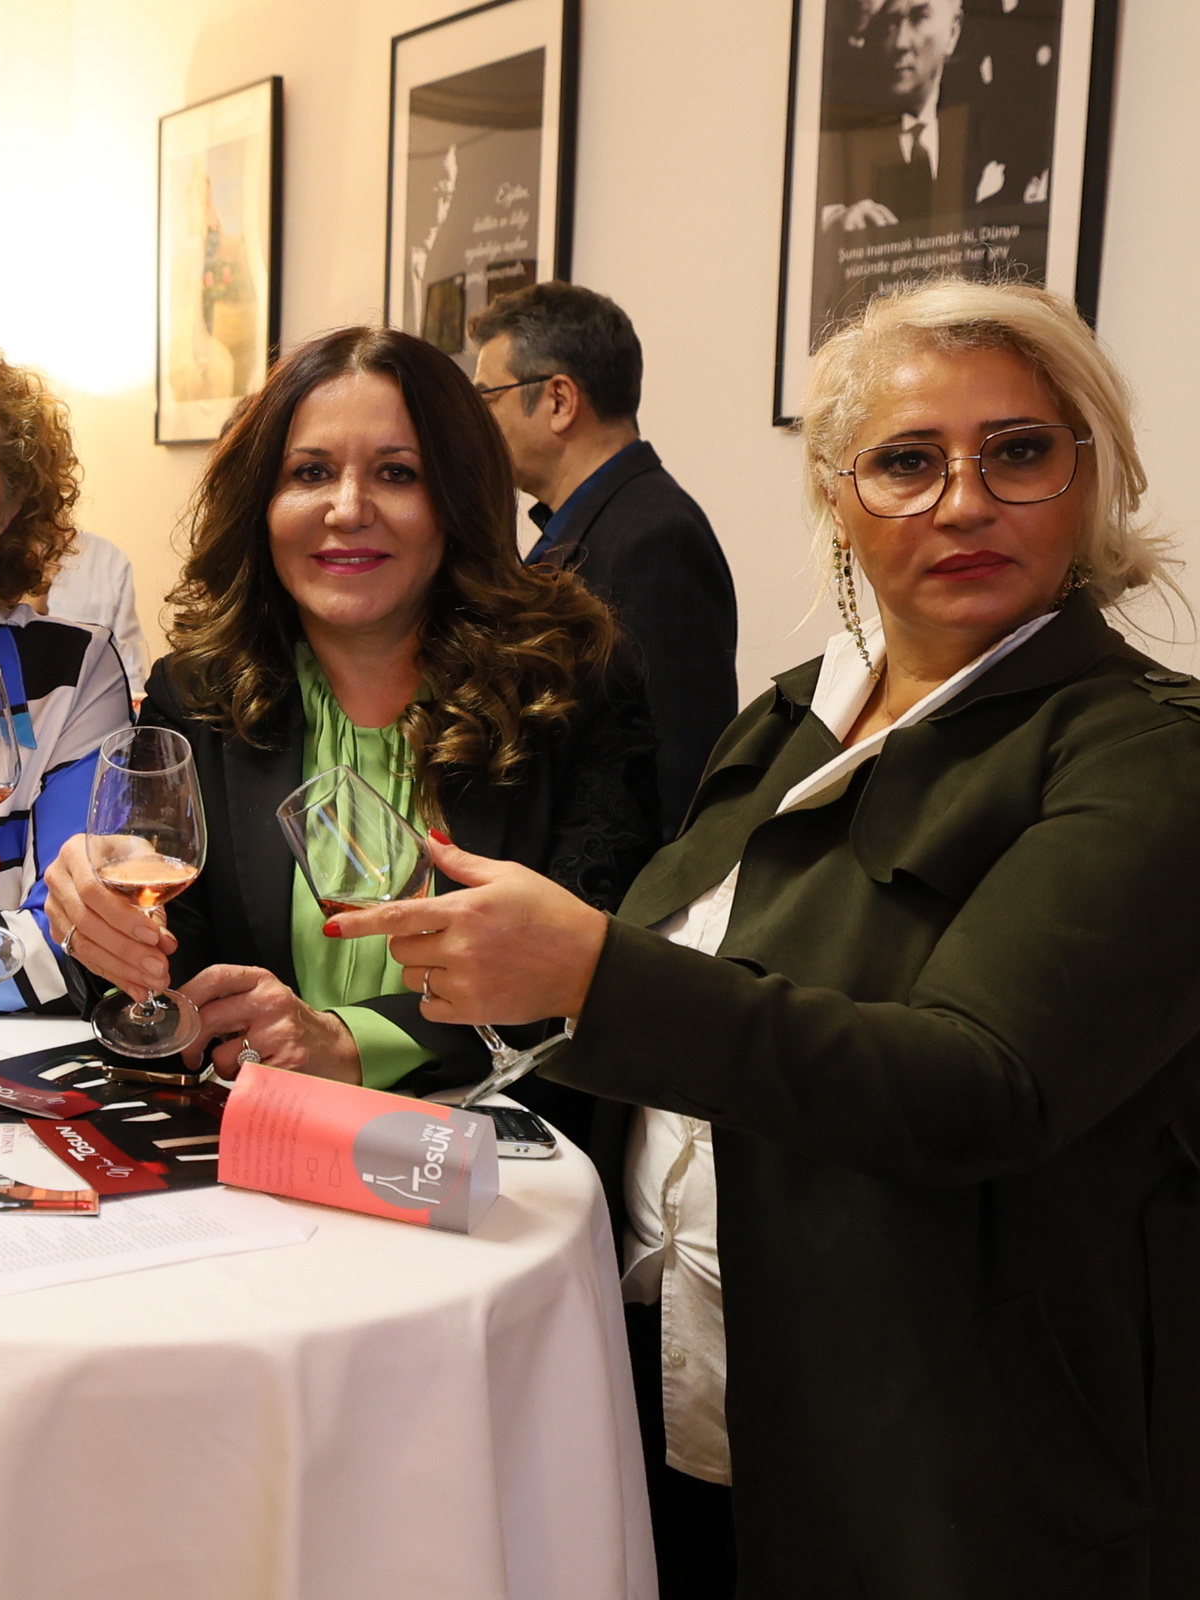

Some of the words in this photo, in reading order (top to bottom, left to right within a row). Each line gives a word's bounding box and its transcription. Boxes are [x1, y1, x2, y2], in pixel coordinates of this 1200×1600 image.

[980, 225, 1020, 241] Dünya
[420, 1123, 436, 1142] VIN
[464, 1121, 478, 1138] Rosé
[55, 1126, 96, 1162] TOSUN
[412, 1126, 455, 1192] TOSUN
